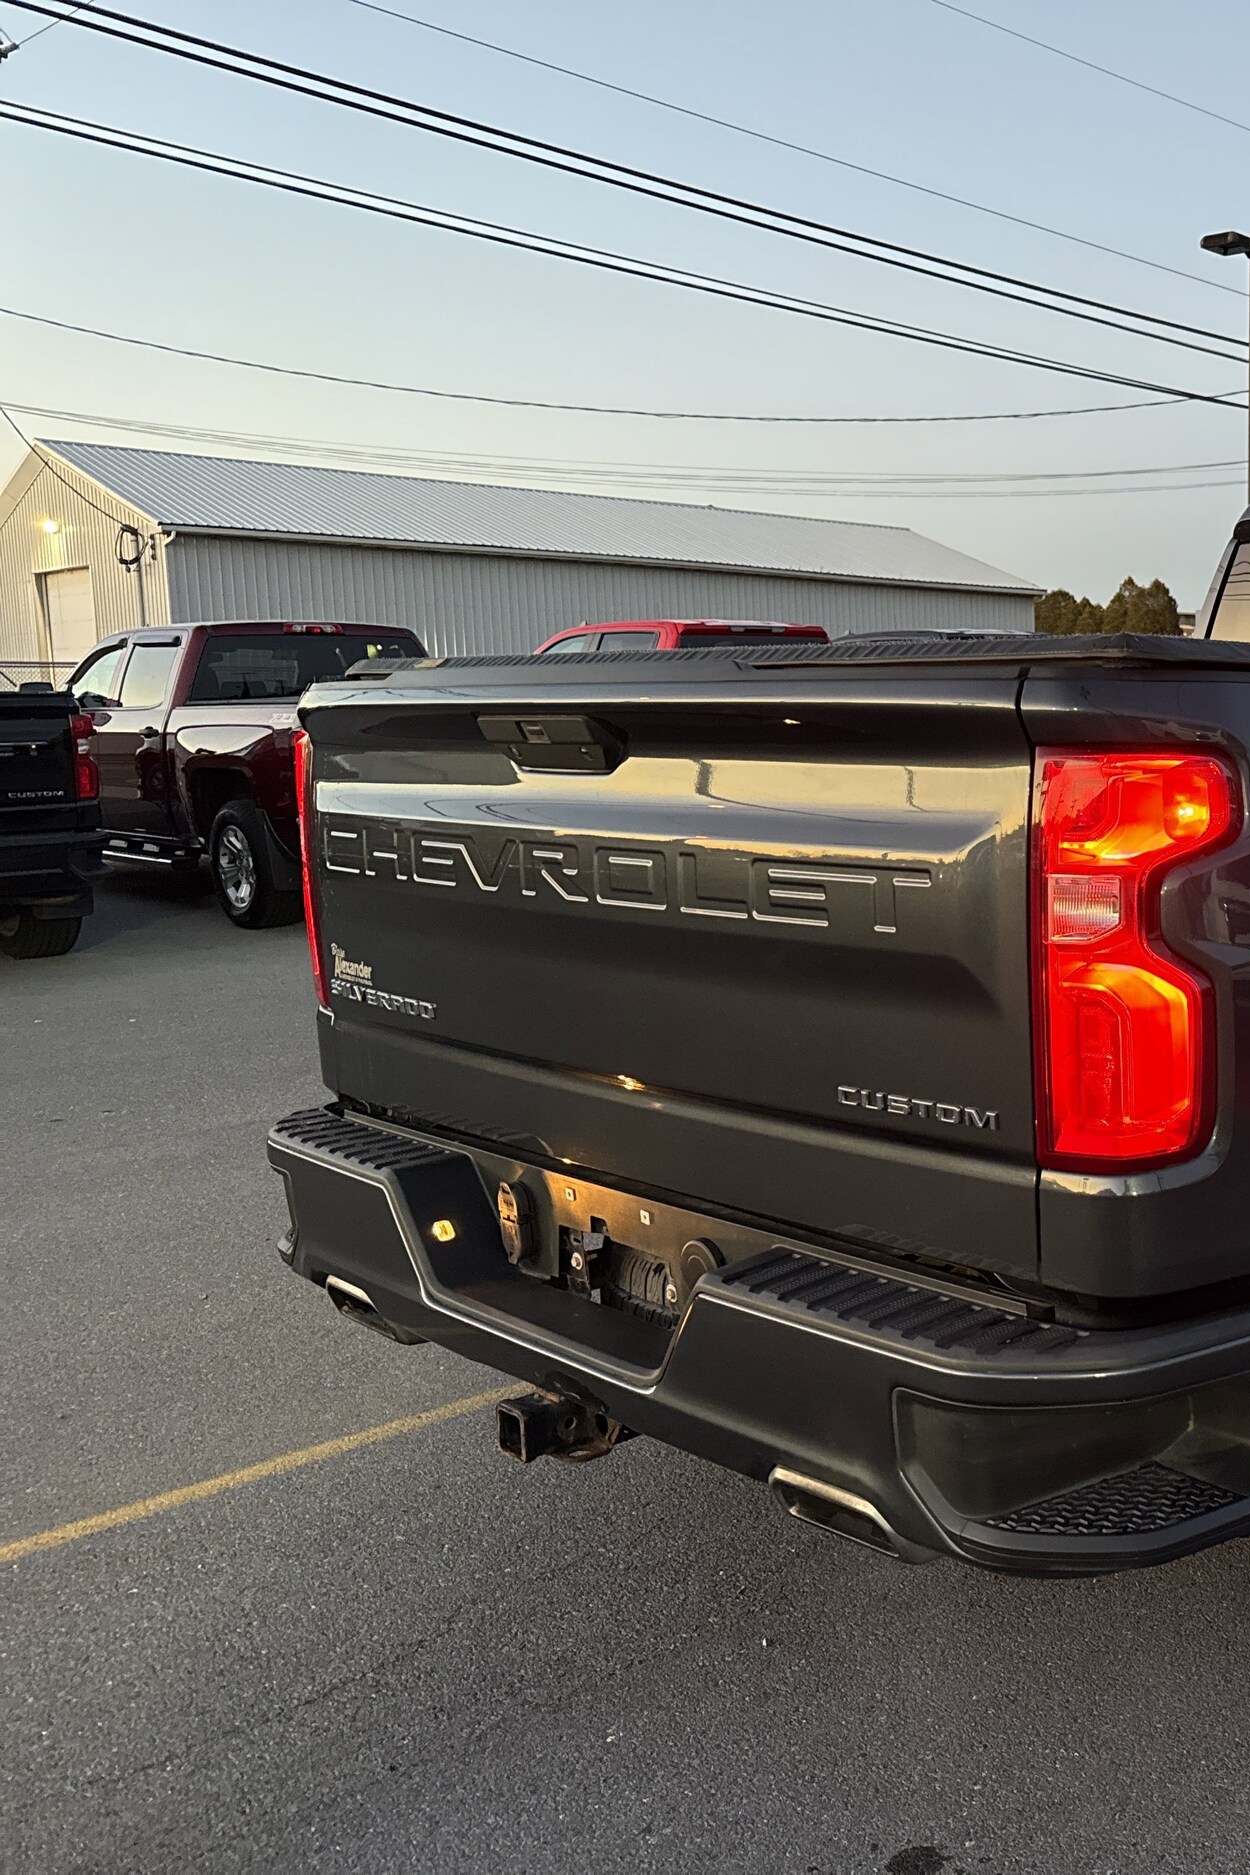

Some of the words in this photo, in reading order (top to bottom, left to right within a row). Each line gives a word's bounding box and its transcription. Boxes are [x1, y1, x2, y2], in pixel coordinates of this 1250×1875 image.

[8, 790, 64, 799] CUSTOM
[323, 827, 932, 933] CHEVROLET
[334, 955, 373, 980] Alexander
[330, 978, 436, 1019] SILVERADO
[837, 1084, 1000, 1131] CUSTOM
